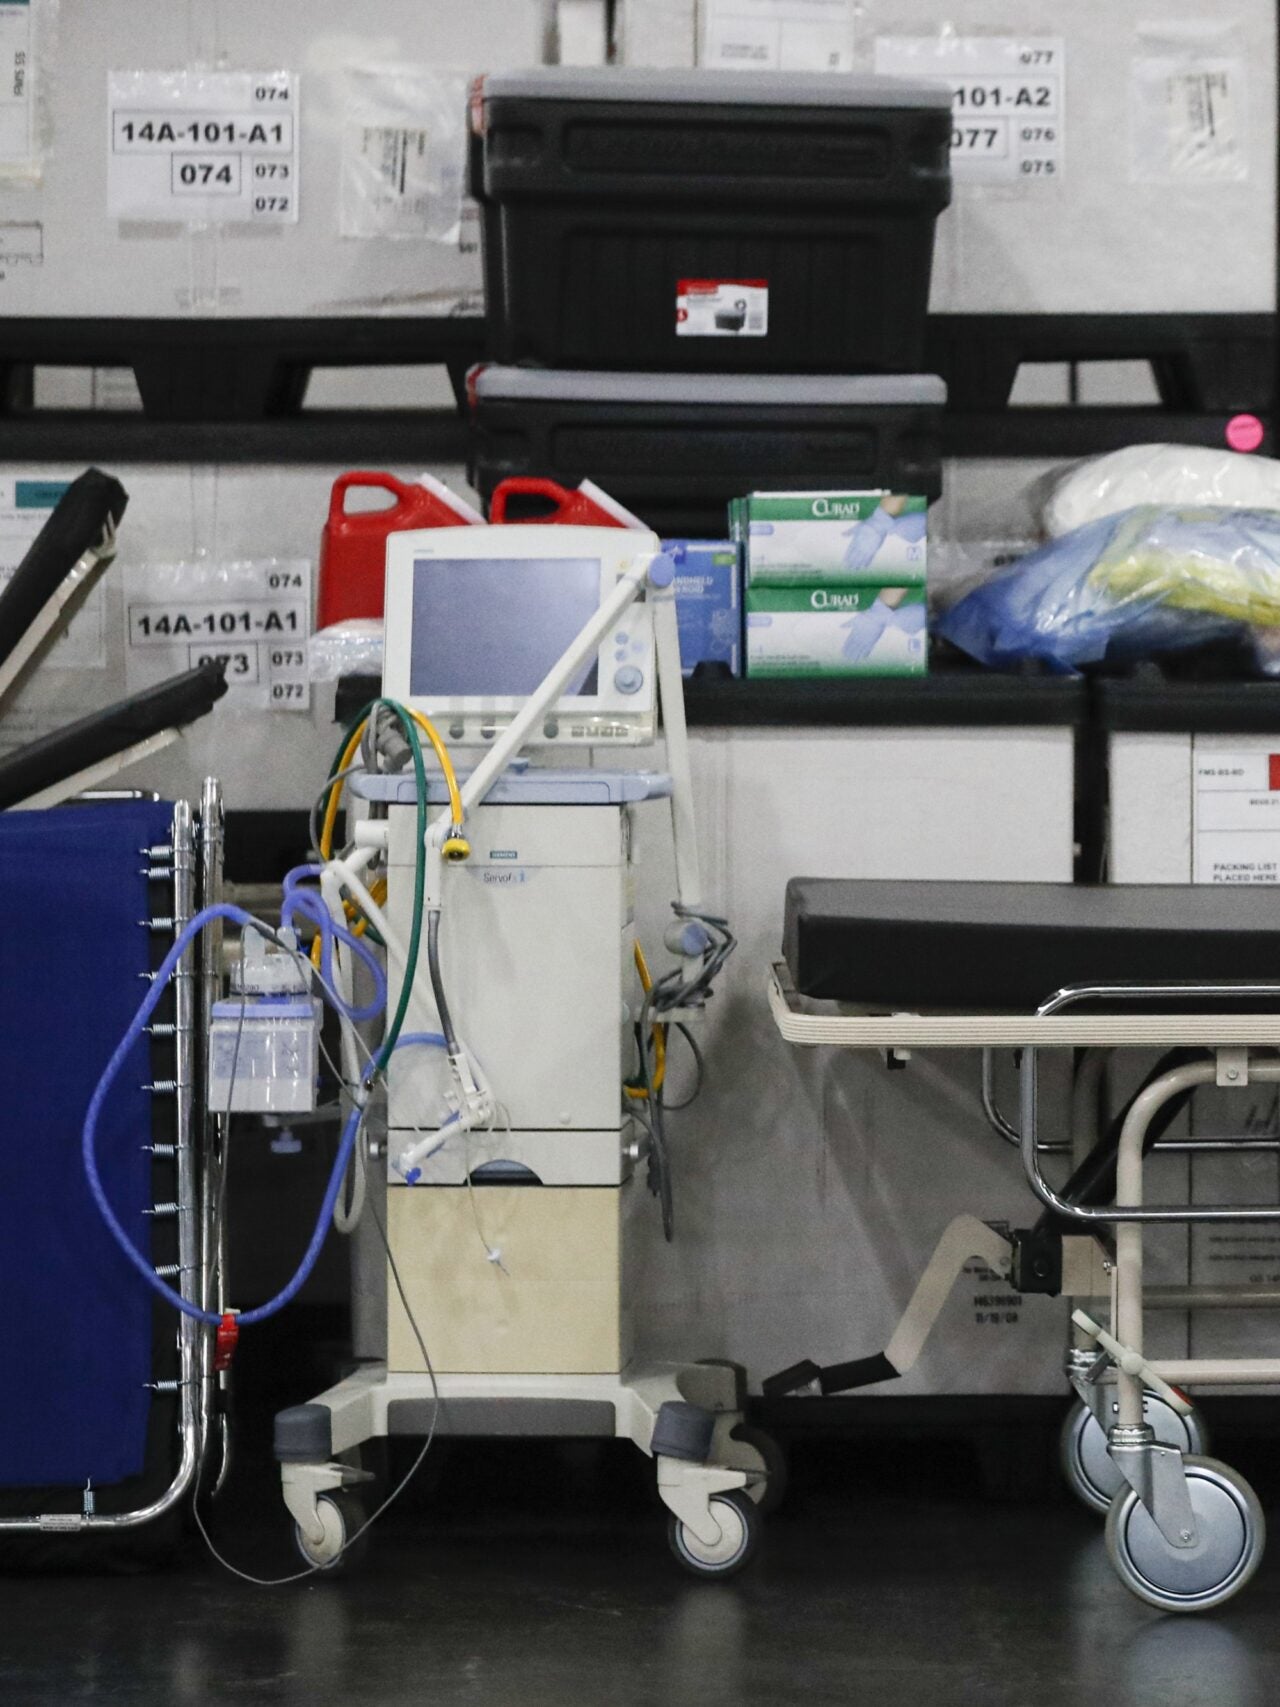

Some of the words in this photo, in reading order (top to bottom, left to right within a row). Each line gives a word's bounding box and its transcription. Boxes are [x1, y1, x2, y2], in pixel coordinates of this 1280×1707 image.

[1019, 50, 1053, 64] 077
[255, 87, 289, 100] 074
[952, 86, 1051, 107] 101-A2
[121, 121, 283, 143] 14A-101-A1
[180, 163, 232, 185] 074
[255, 164, 289, 179] 073
[255, 197, 289, 211] 072
[812, 498, 860, 517] CURAD
[268, 573, 303, 589] 074
[810, 590, 860, 609] CURAD
[137, 610, 298, 636] 14A-101-A1
[272, 651, 304, 666] 073
[272, 684, 304, 699] 072
[1213, 863, 1255, 871] PACKING
[1257, 863, 1278, 871] LIST
[1213, 874, 1251, 882] PLACED
[1253, 874, 1277, 882] HERE
